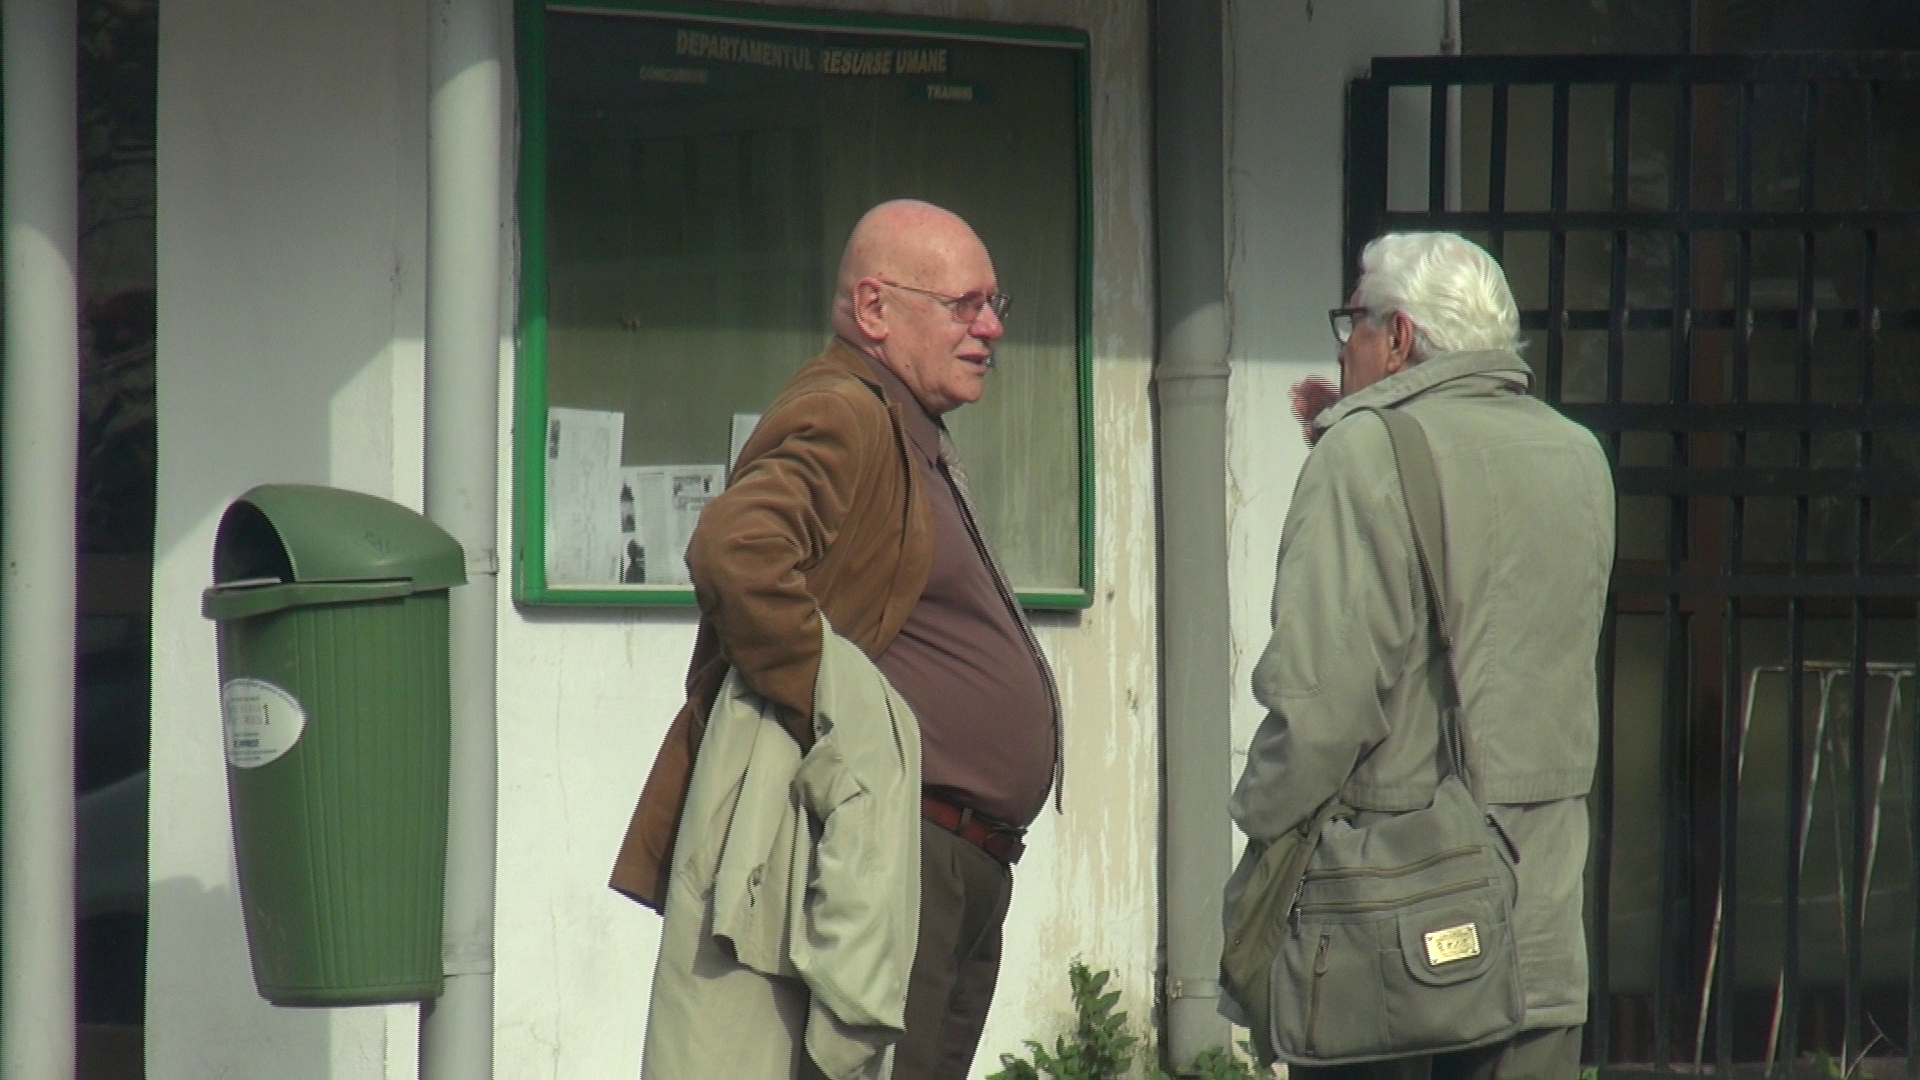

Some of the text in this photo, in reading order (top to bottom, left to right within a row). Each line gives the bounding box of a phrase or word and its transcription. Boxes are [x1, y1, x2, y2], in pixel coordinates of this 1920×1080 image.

[677, 30, 948, 75] DEPARTAMENTUL RESURSE UMANE
